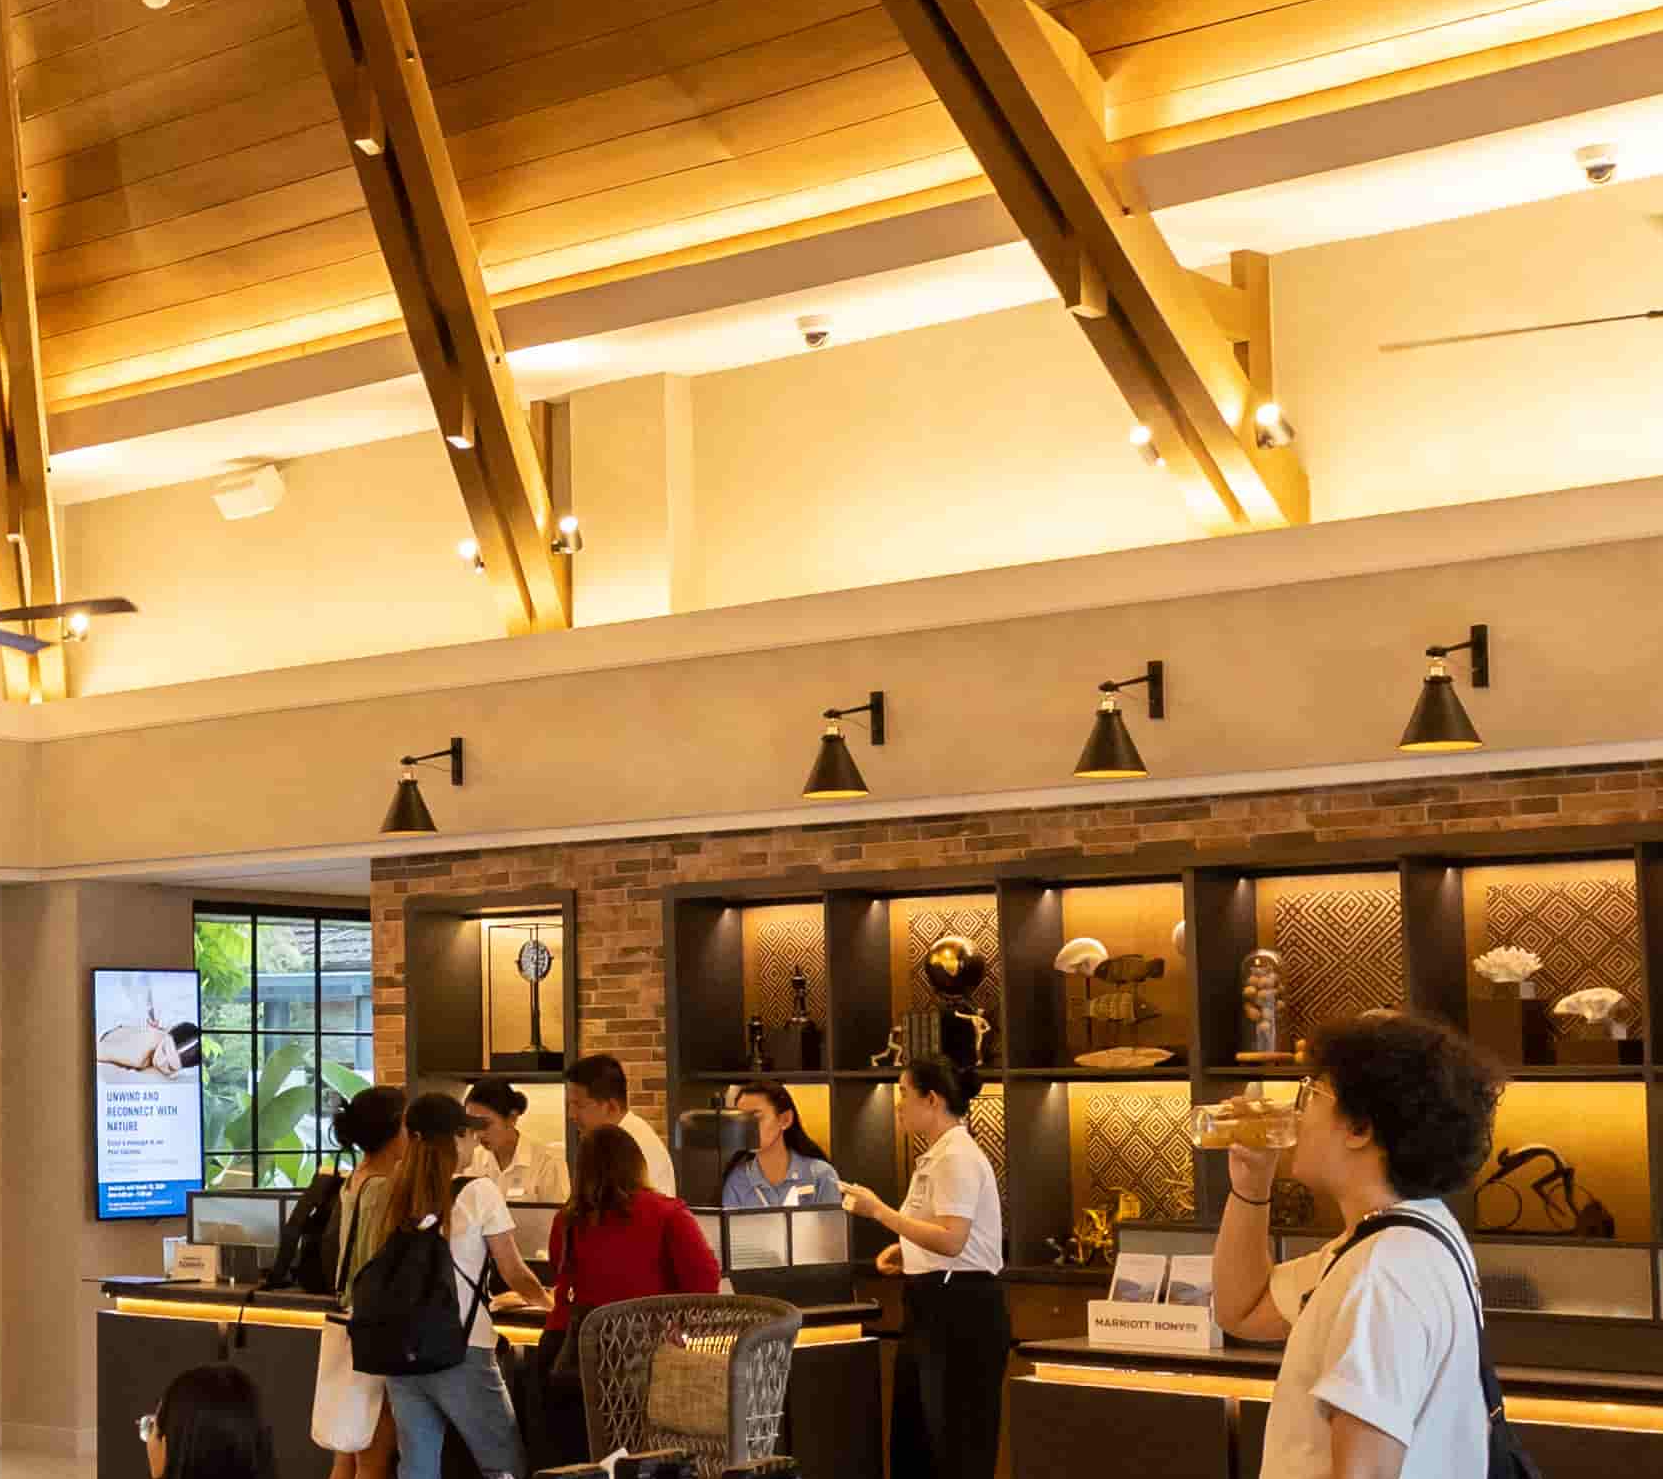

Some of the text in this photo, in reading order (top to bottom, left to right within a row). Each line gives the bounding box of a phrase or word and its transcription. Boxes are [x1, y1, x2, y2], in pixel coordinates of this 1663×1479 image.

[156, 1105, 178, 1115] WITH
[106, 1121, 138, 1132] NATURE
[1094, 1317, 1151, 1330] MARRIOTT
